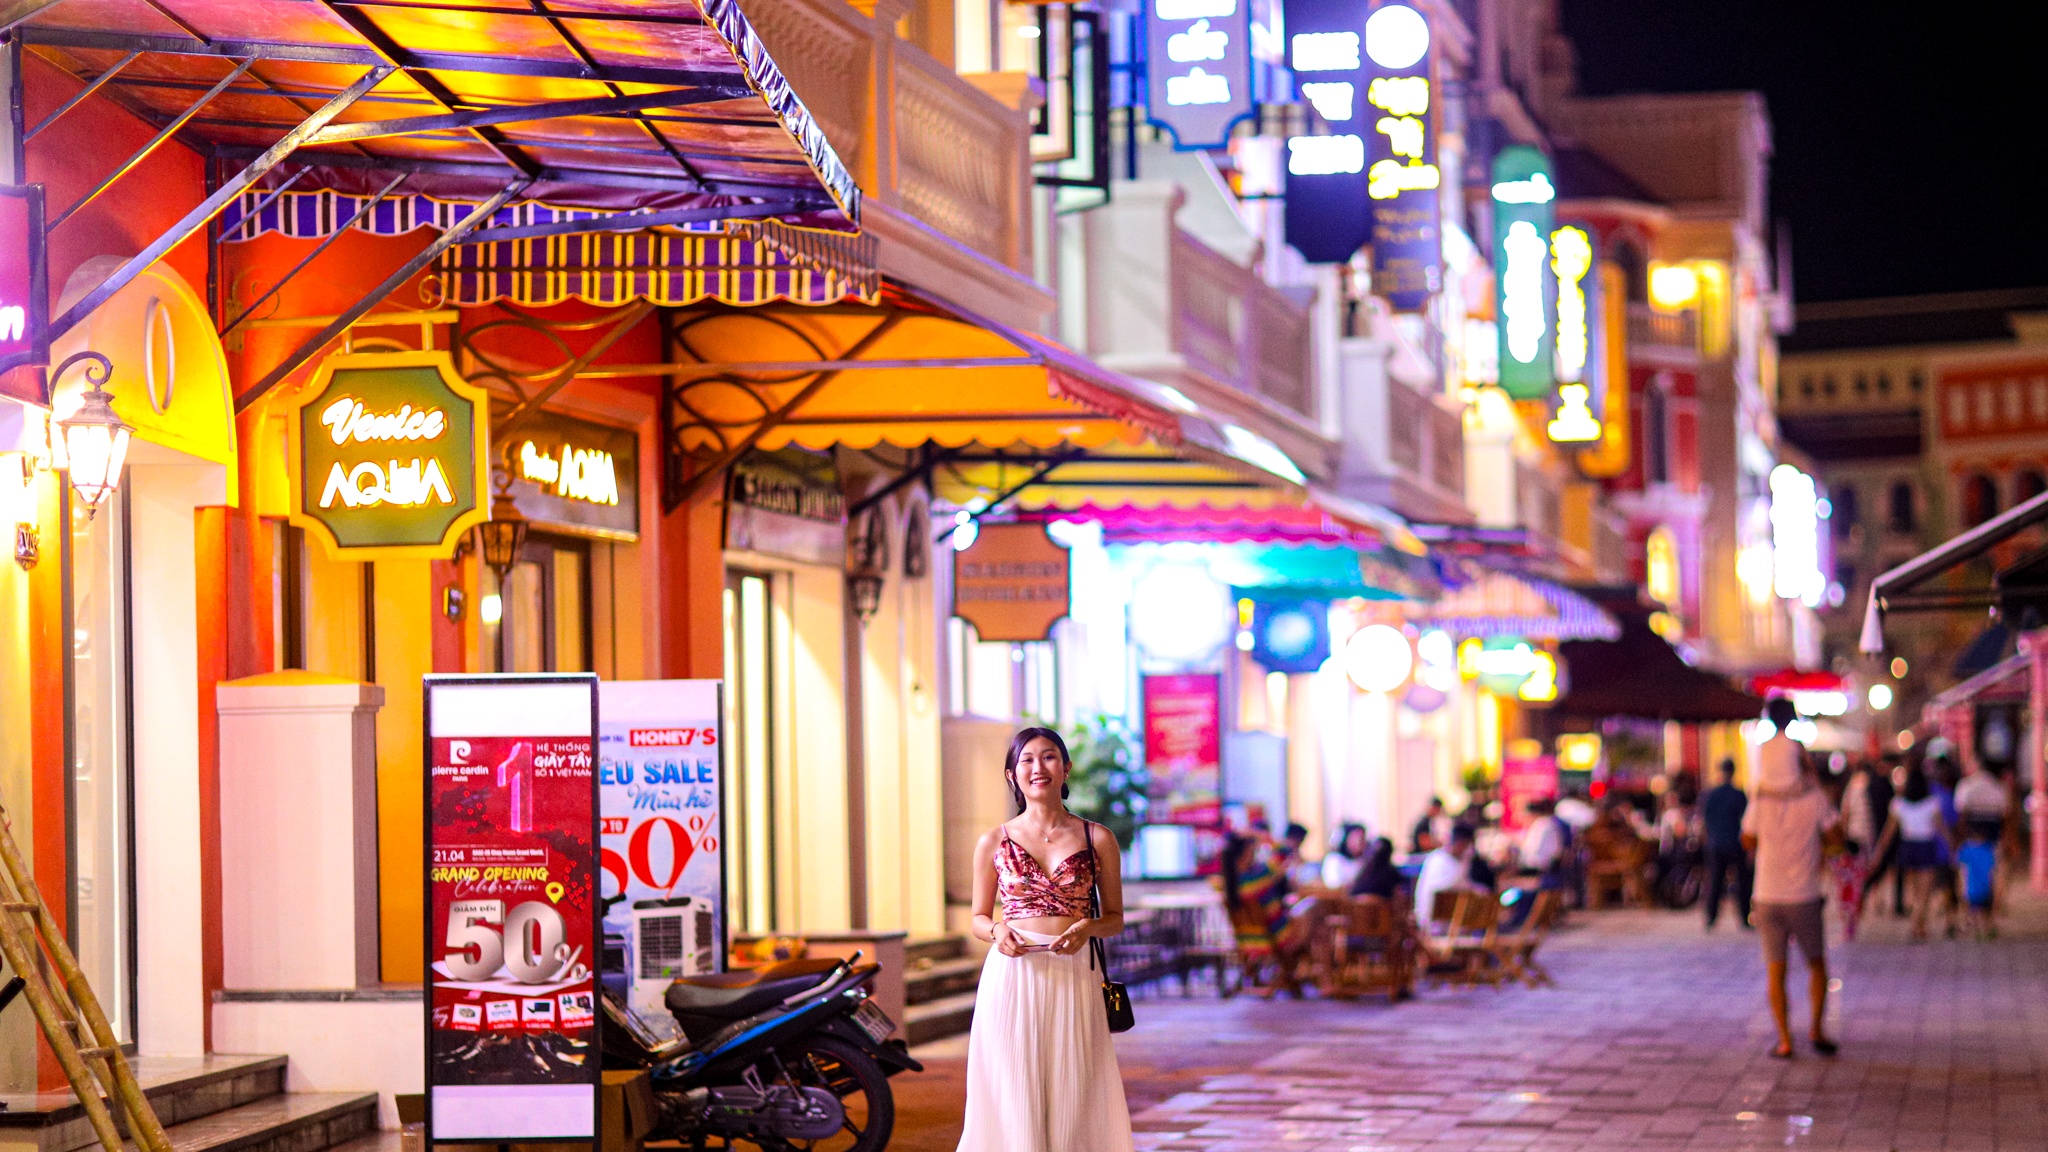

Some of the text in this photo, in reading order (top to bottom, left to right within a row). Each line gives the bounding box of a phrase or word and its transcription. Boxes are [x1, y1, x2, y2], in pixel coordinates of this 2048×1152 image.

[321, 397, 445, 445] Venice
[534, 751, 592, 768] GIÀY TÂY
[432, 765, 489, 776] pierre cardin
[644, 758, 714, 784] SALE
[434, 849, 464, 862] 21.04
[431, 866, 549, 883] GRAND OPENING
[445, 899, 588, 985] 50%
